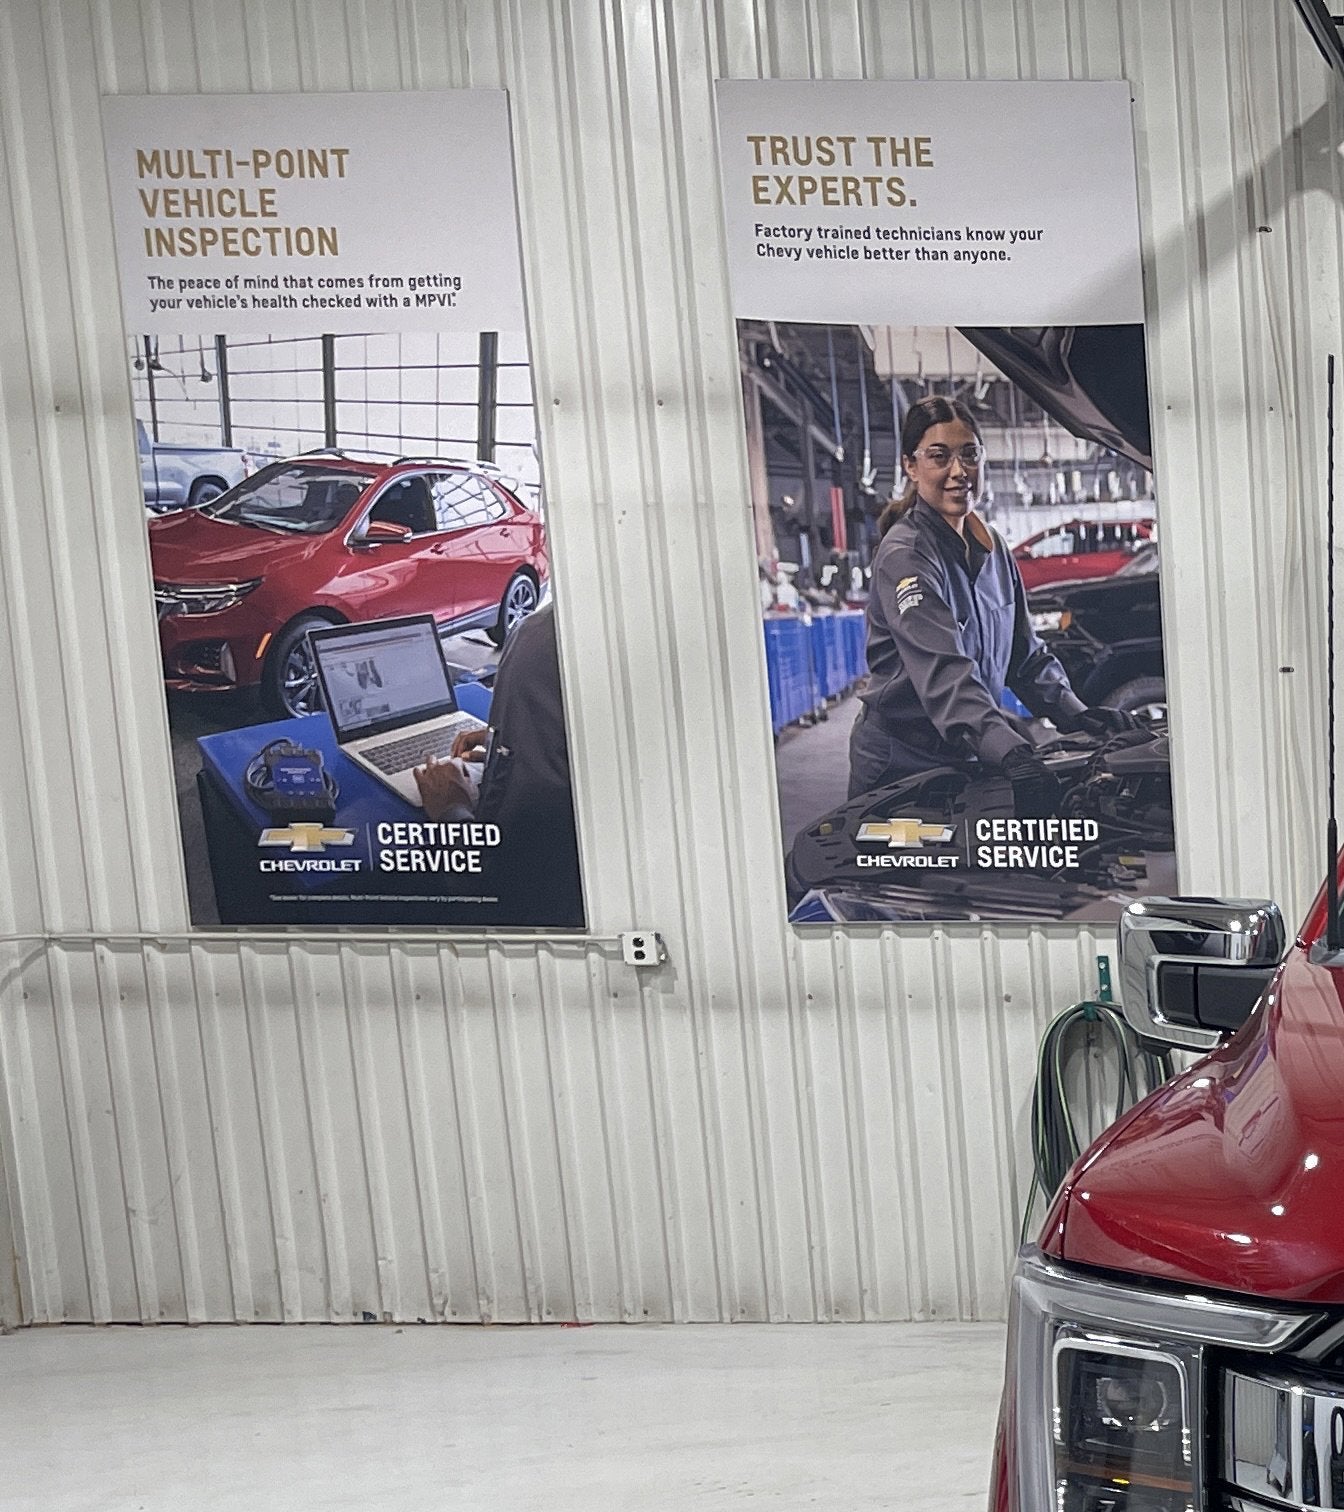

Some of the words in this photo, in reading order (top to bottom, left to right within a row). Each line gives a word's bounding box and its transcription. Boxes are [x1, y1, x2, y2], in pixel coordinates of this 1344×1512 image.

[747, 136, 856, 166] TRUST
[867, 137, 933, 167] THE
[136, 149, 349, 179] MULTI-POINT
[752, 176, 916, 206] EXPERTS.
[138, 189, 277, 218] VEHICLE
[144, 227, 338, 257] INSPECTION
[755, 224, 812, 242] Factory
[817, 225, 871, 239] trained
[876, 226, 961, 240] technicians
[966, 227, 1005, 240] know
[1010, 230, 1043, 244] your
[757, 243, 802, 261] Chevy
[806, 245, 859, 259] vehicle
[864, 246, 910, 260] better
[915, 247, 948, 260] than
[954, 249, 1012, 264] anyone.
[147, 276, 174, 289] The
[179, 279, 220, 295] peace
[225, 275, 239, 289] of
[244, 275, 279, 288] mind
[283, 275, 313, 288] that
[318, 278, 364, 288] comes
[368, 274, 403, 288] from
[409, 273, 461, 292] getting
[150, 299, 182, 312] your
[187, 295, 247, 308] vehicle's
[252, 295, 297, 308] health
[302, 294, 361, 308] checked
[366, 294, 398, 307] with
[403, 297, 411, 307] a
[377, 823, 500, 846] CERTIFIED
[975, 819, 1098, 842] CERTIFIED
[260, 859, 362, 872] CHEVROLET
[380, 849, 481, 873] SERVICE
[857, 855, 959, 868] CHEVROLET
[977, 846, 1079, 868] SERVICE
